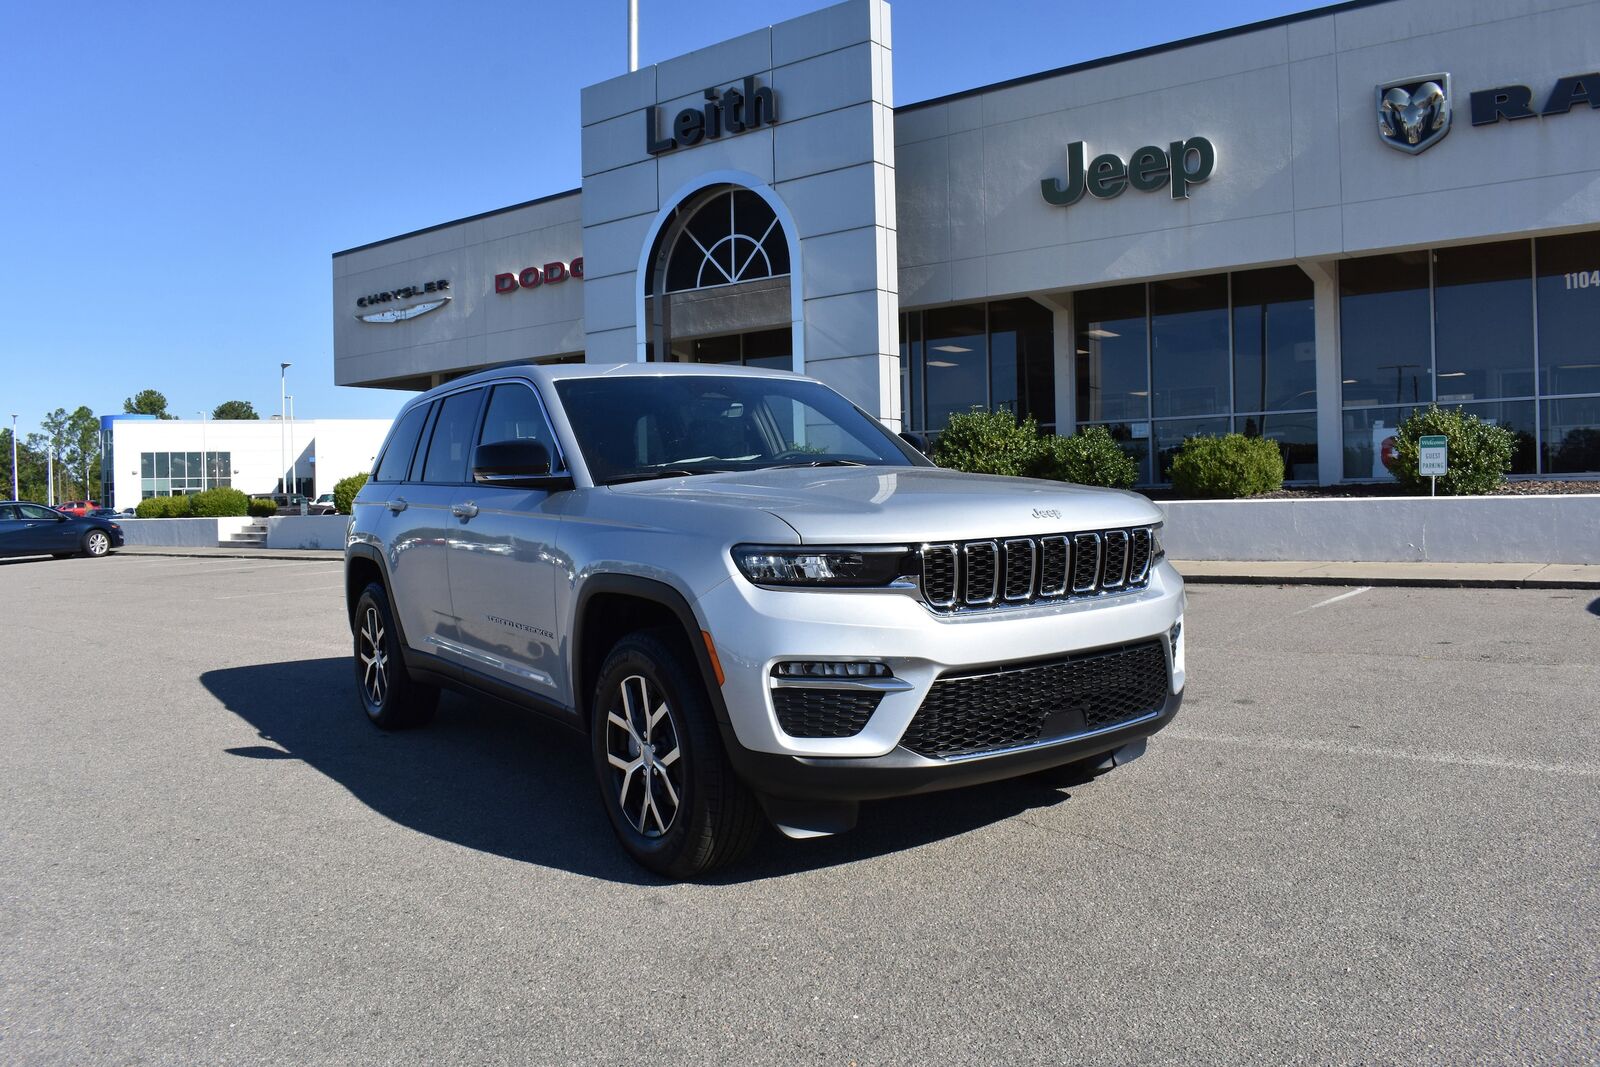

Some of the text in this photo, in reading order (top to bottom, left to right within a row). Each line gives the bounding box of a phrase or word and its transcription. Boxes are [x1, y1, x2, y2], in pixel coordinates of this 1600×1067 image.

[1470, 72, 1600, 126] RA
[646, 76, 777, 155] Leith
[1040, 136, 1217, 206] Jeep
[1564, 270, 1600, 290] 1104
[357, 279, 450, 307] CHRYSLER
[1422, 462, 1445, 470] PARKING
[1425, 452, 1441, 460] GUEST
[1031, 507, 1062, 520] Jeep
